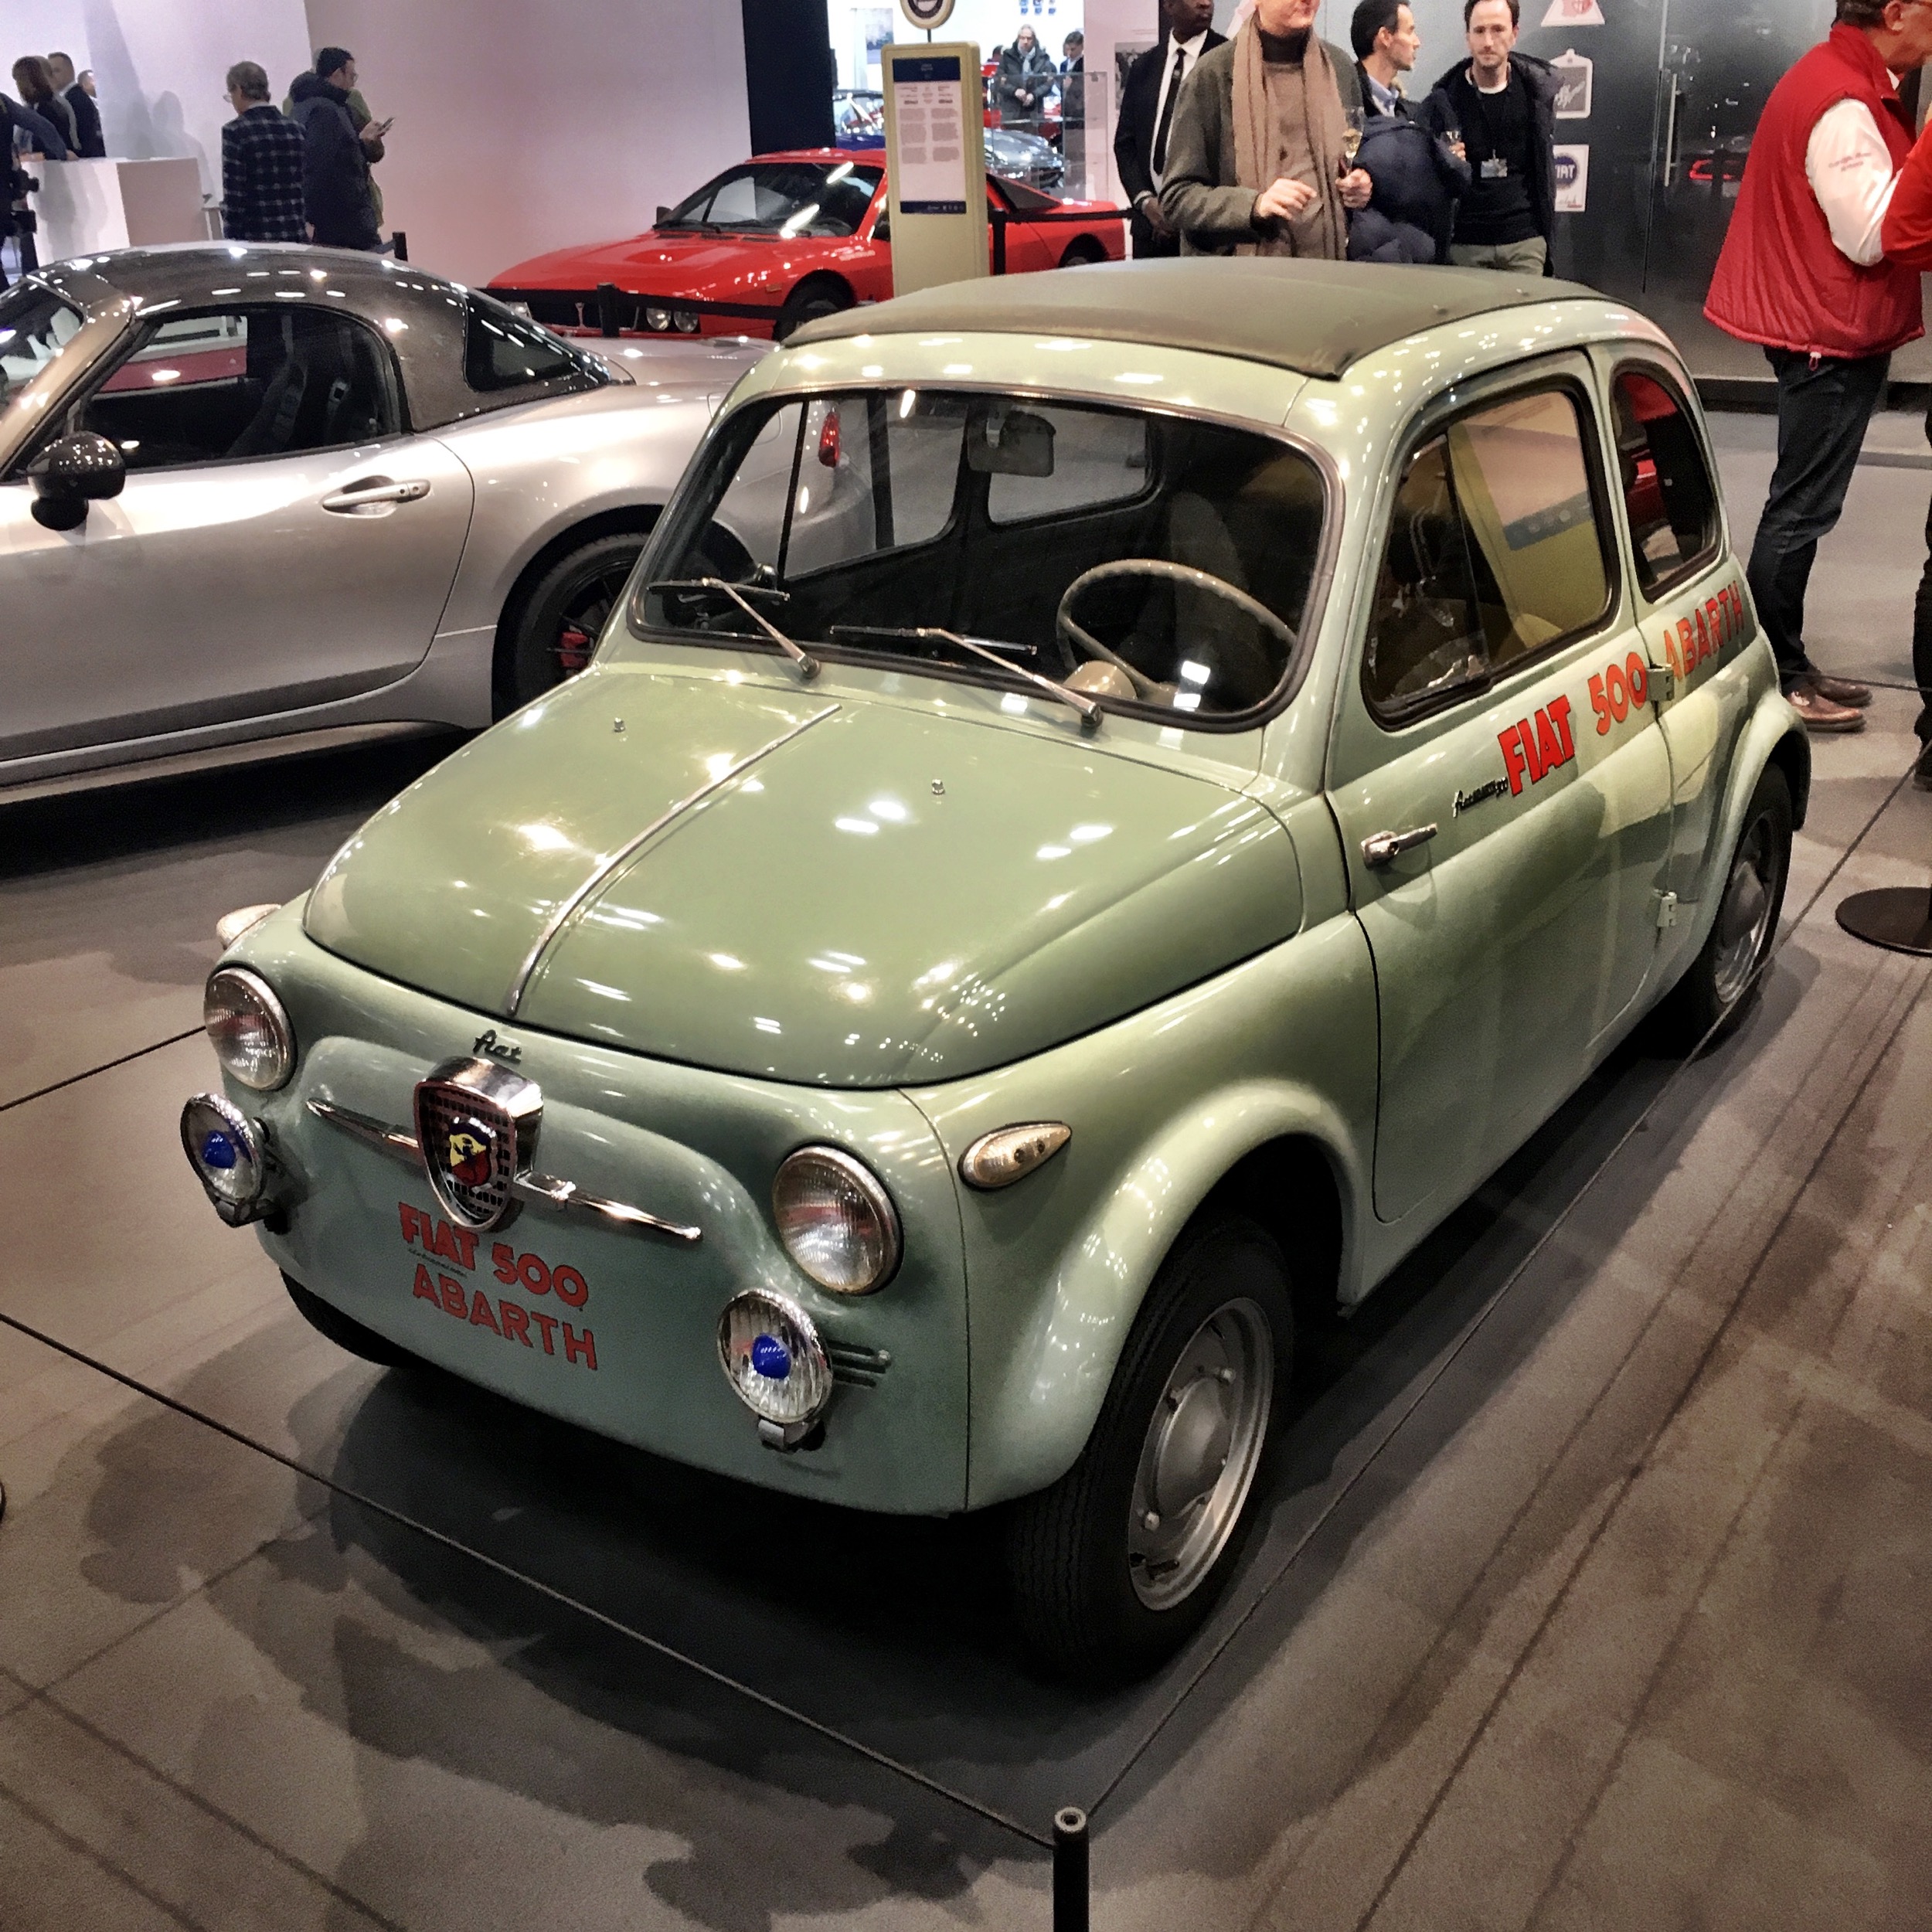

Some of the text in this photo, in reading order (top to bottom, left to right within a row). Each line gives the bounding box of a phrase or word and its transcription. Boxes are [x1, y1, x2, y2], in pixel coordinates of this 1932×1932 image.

[1555, 164, 1575, 179] IAT
[1498, 580, 1744, 797] FIAT 500 ABARTH
[399, 1202, 479, 1271] FIAT
[492, 1242, 588, 1307] 500
[413, 1264, 598, 1370] ABARTH
